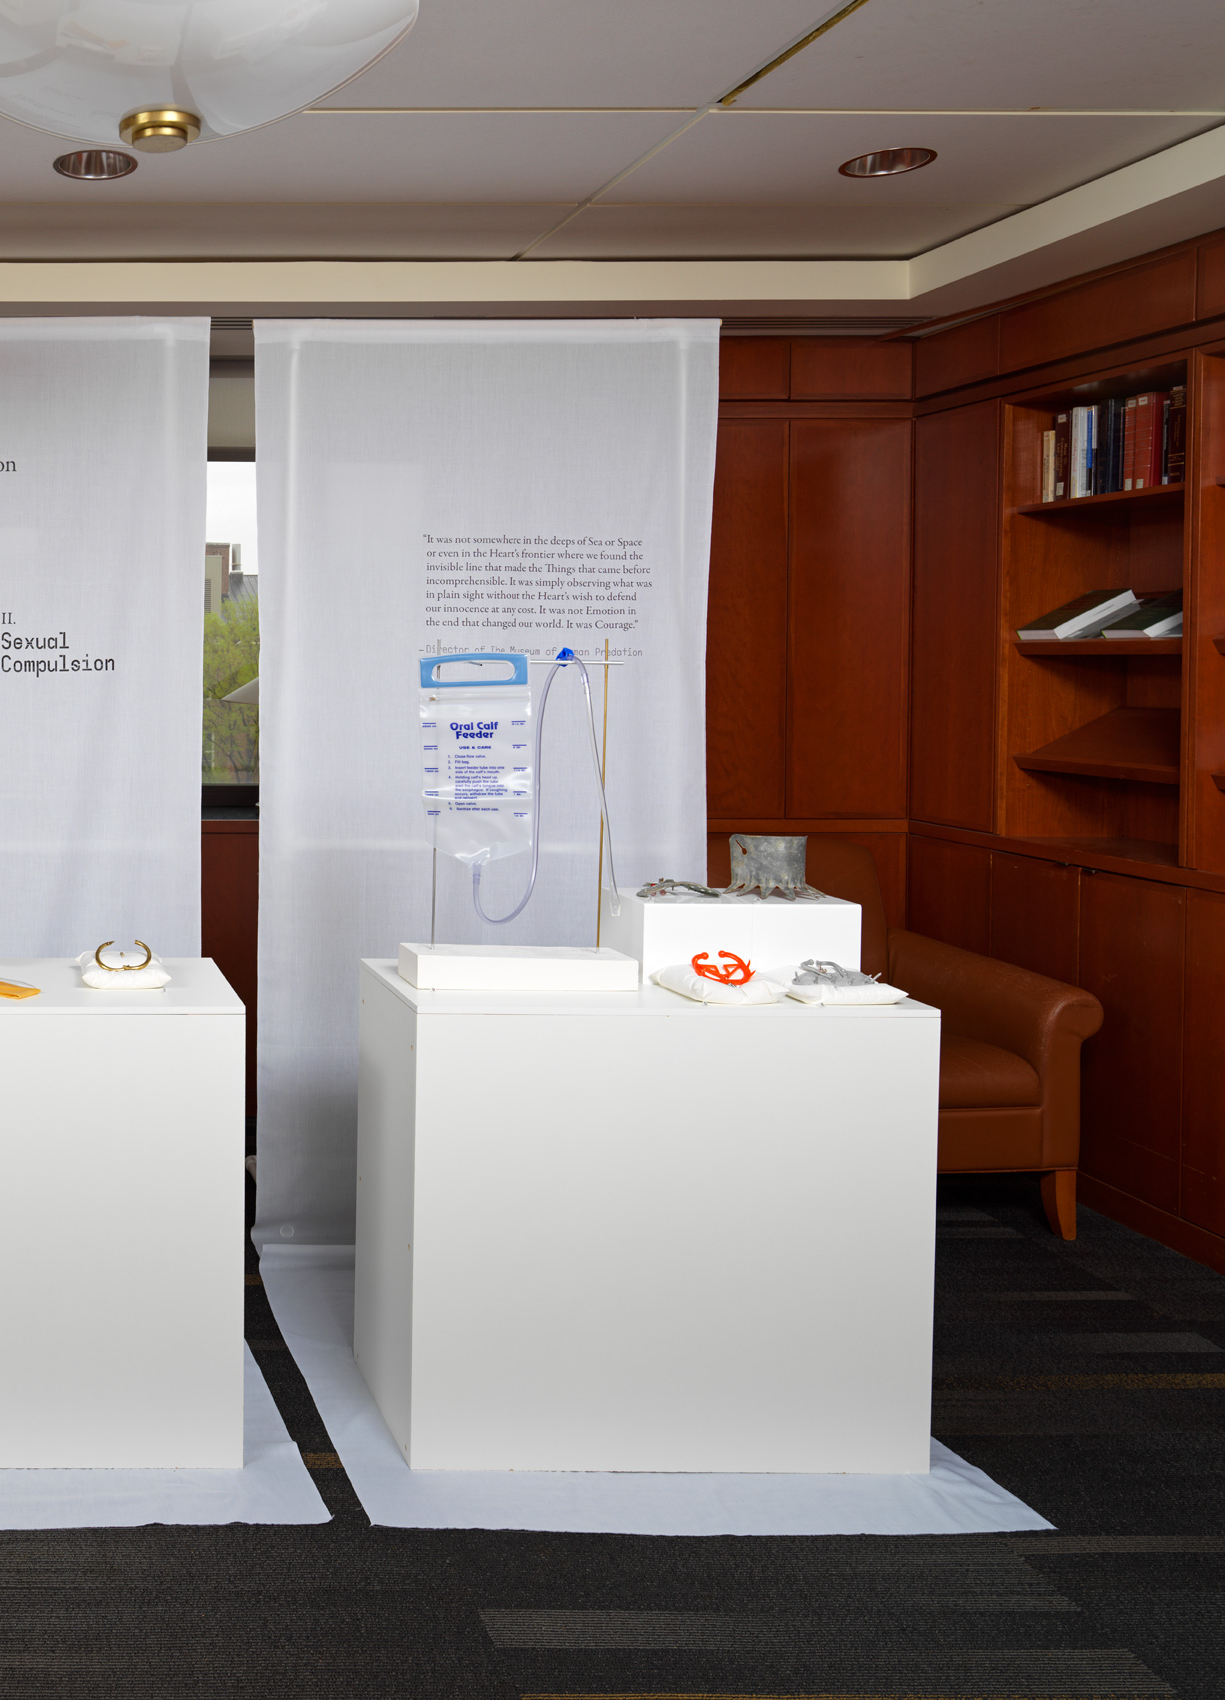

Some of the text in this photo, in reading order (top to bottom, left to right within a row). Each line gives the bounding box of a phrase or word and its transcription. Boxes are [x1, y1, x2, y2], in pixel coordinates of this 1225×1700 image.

[454, 536, 472, 544] not
[472, 534, 522, 545] somewhere
[522, 535, 532, 545] in
[533, 535, 549, 546] the
[549, 535, 576, 549] deeps
[576, 535, 588, 546] of
[587, 536, 603, 547] Sea
[604, 539, 616, 547] or
[617, 537, 643, 550] Space
[426, 550, 437, 558] or
[437, 550, 460, 558] even
[461, 548, 471, 558] in
[472, 547, 488, 558] the
[521, 548, 556, 559] frontier
[556, 549, 585, 560] where
[599, 550, 628, 561] found
[629, 550, 644, 561] the
[426, 561, 651, 577] invisible line that made the Things that came before
[426, 575, 508, 588] incomprehensible.
[509, 576, 517, 586] It
[517, 579, 534, 587] was
[534, 576, 566, 590] simply
[566, 577, 612, 591] observing
[612, 577, 635, 588] what
[425, 589, 436, 599] in
[436, 589, 461, 602] plain
[462, 589, 485, 603] sight
[486, 589, 521, 600] without
[521, 590, 536, 601] the
[571, 591, 593, 602] wish
[595, 594, 606, 602] to
[606, 591, 637, 602] defend
[425, 603, 637, 617] our innocence at any cost. It was not Emotion in
[0, 612, 16, 625] II.
[425, 616, 441, 627] the
[441, 616, 460, 627] end
[461, 616, 480, 627] that
[481, 617, 517, 631] changed
[534, 618, 564, 629] world.
[566, 619, 574, 629] It
[575, 622, 593, 630] was
[1, 632, 70, 650] Sexual
[545, 646, 557, 656] of
[0, 654, 115, 678] Compulsion
[449, 721, 499, 731] Oral Calf
[455, 731, 494, 740] Feeder
